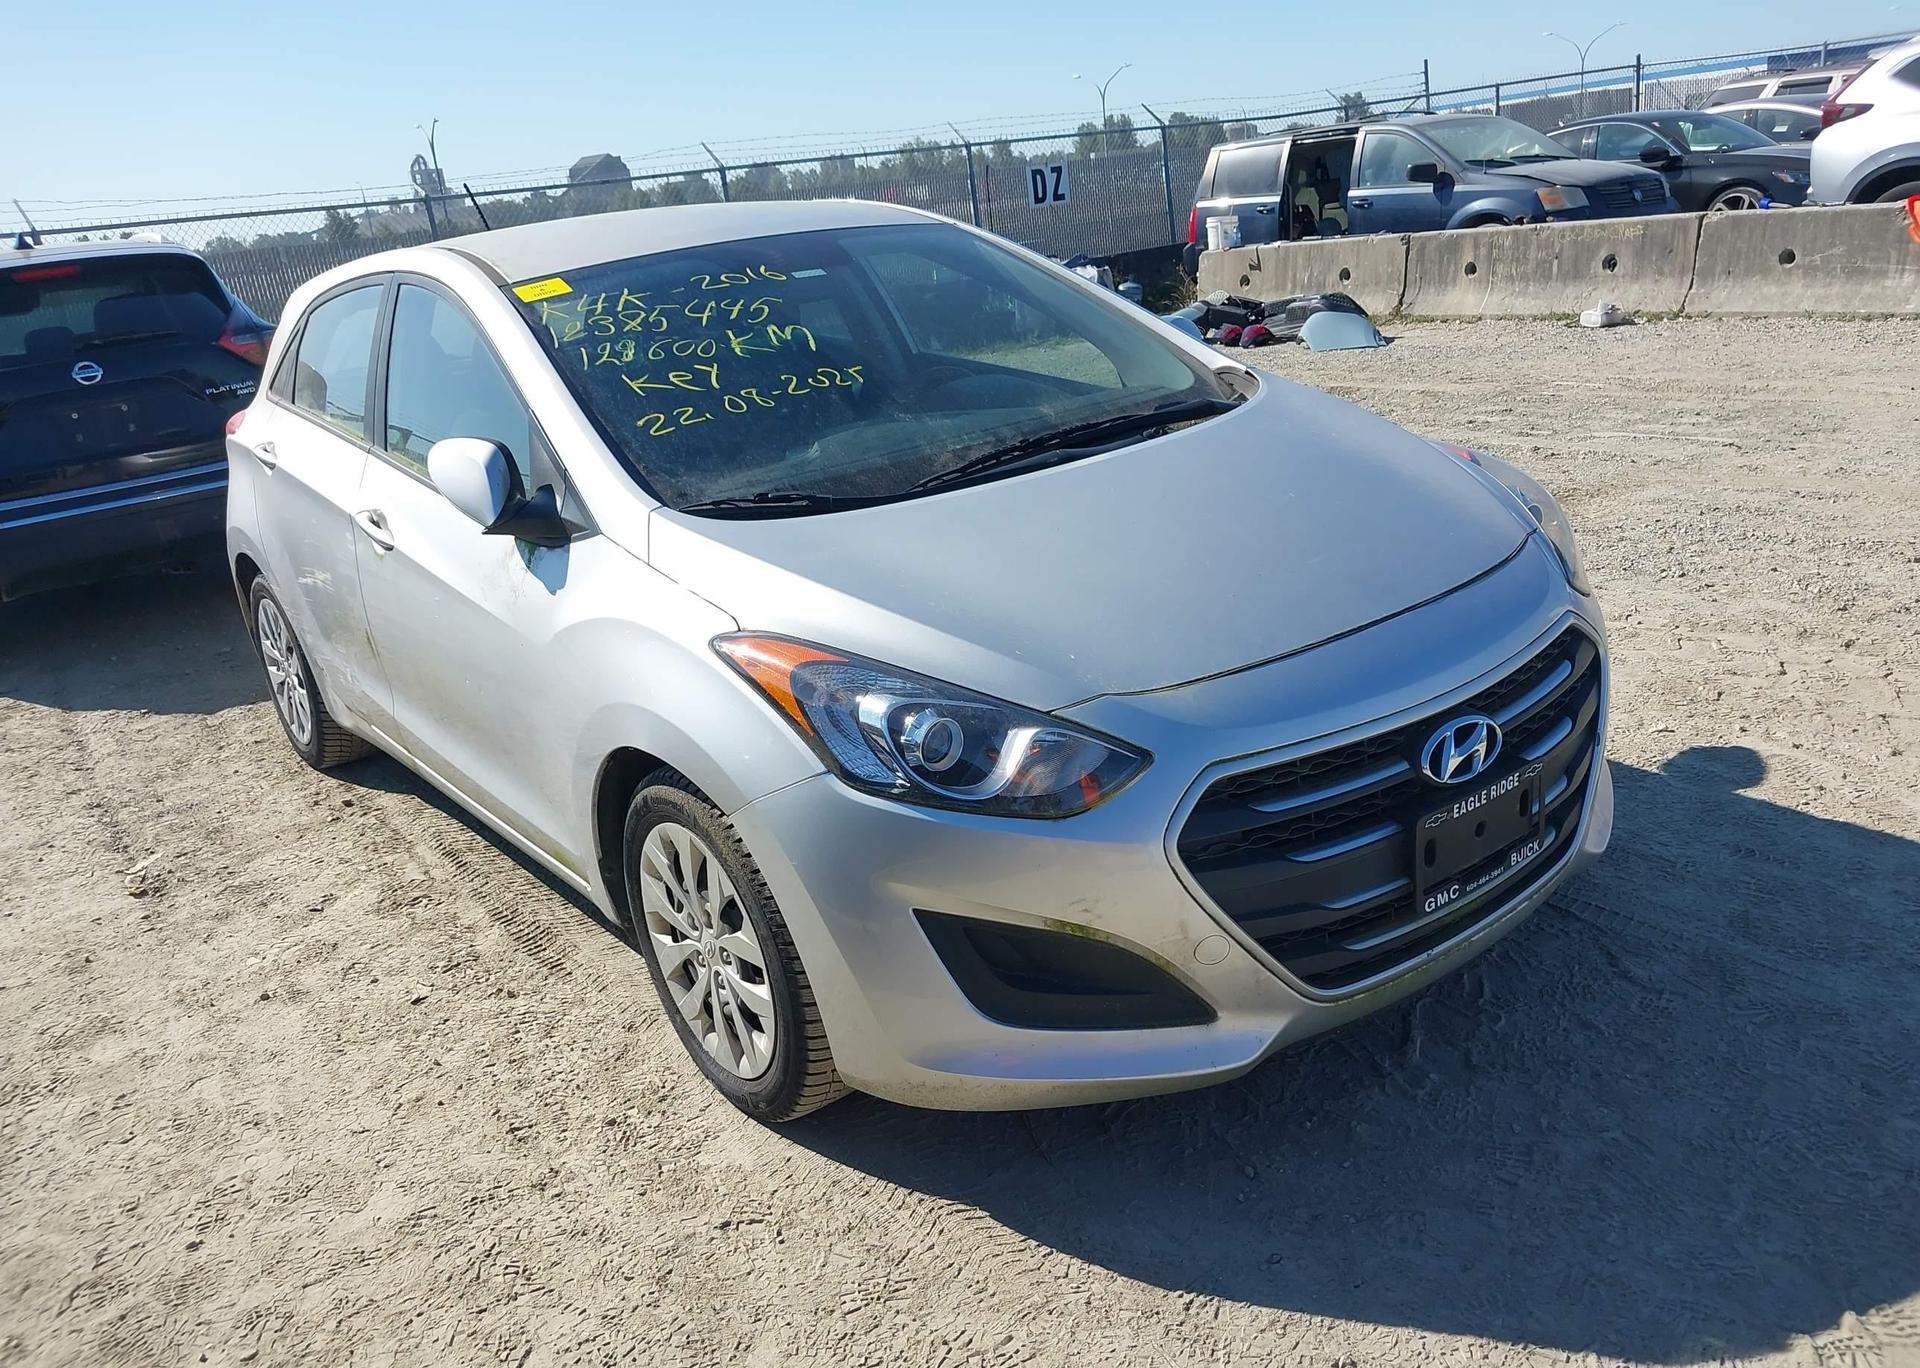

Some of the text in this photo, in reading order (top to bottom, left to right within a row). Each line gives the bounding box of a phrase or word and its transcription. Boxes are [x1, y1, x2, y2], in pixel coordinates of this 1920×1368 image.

[1031, 165, 1066, 205] DZ
[689, 265, 788, 290] 2016
[726, 324, 817, 358] KM
[205, 380, 254, 395] PLATINUM
[236, 386, 256, 396] AWD
[1452, 773, 1520, 819] EAGLE RIDGE
[1424, 884, 1461, 913] GMC
[1510, 839, 1541, 867] BUICK
